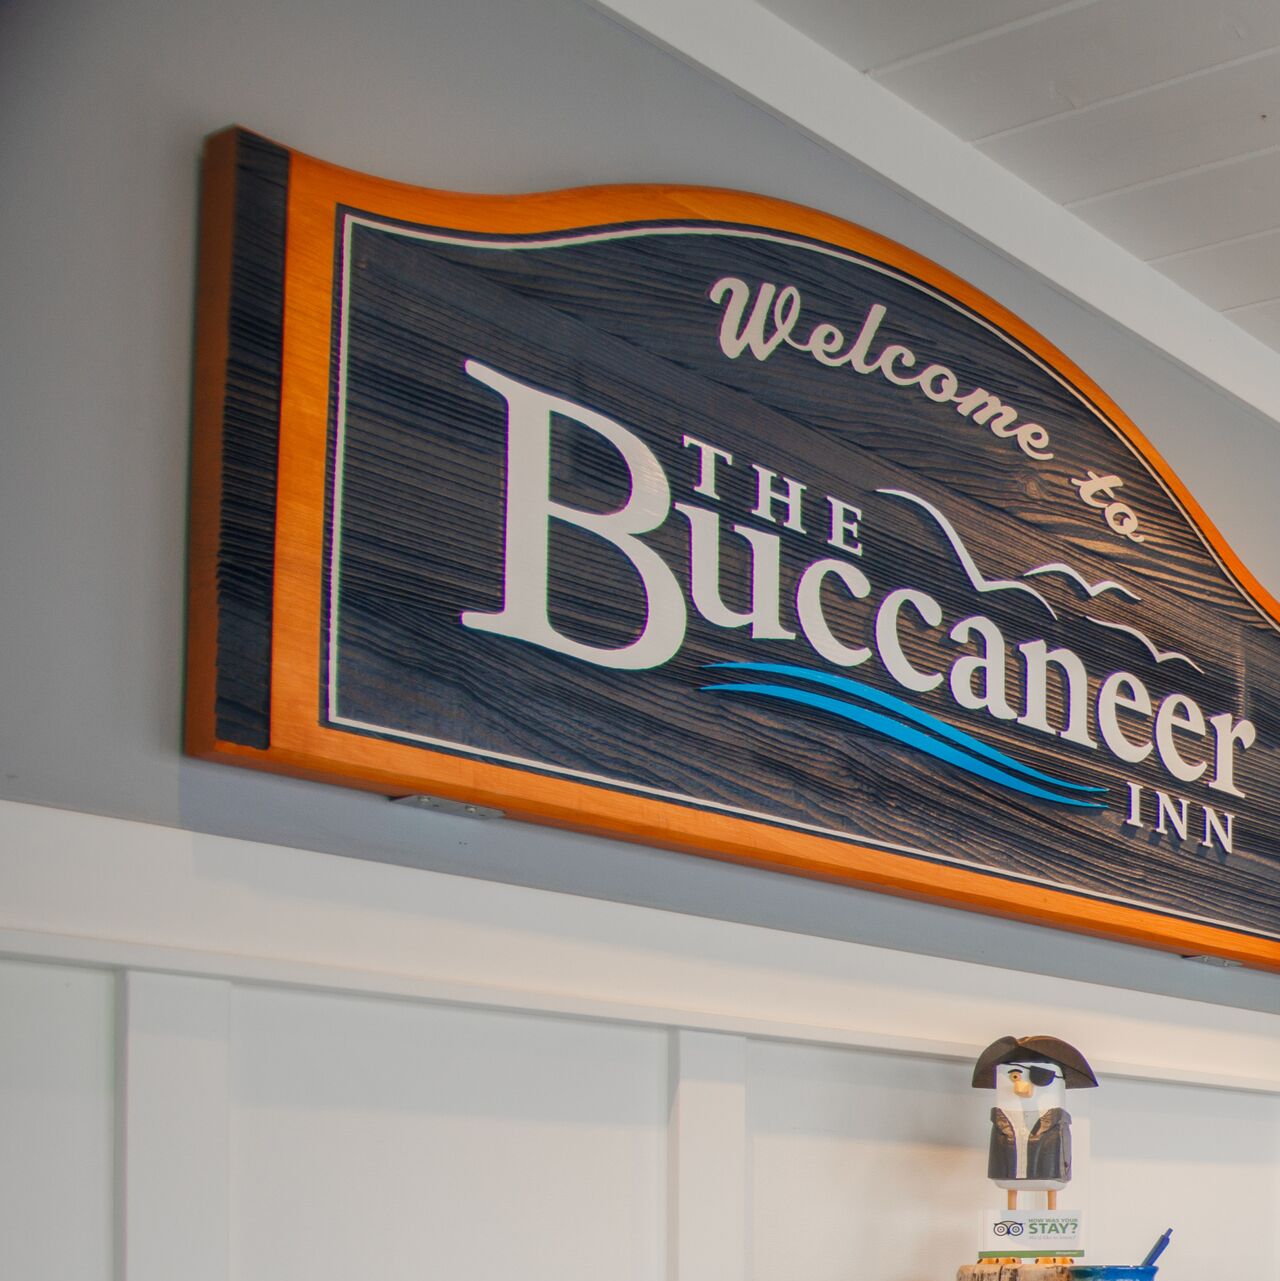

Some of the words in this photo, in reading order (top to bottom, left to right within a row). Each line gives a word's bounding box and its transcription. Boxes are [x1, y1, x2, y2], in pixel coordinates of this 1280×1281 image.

[709, 276, 1055, 461] Welcome
[1070, 470, 1146, 543] to
[682, 434, 864, 556] THE
[460, 358, 1257, 800] Buccaneer
[1125, 781, 1236, 855] INN
[1028, 1223, 1078, 1234] STAY?
